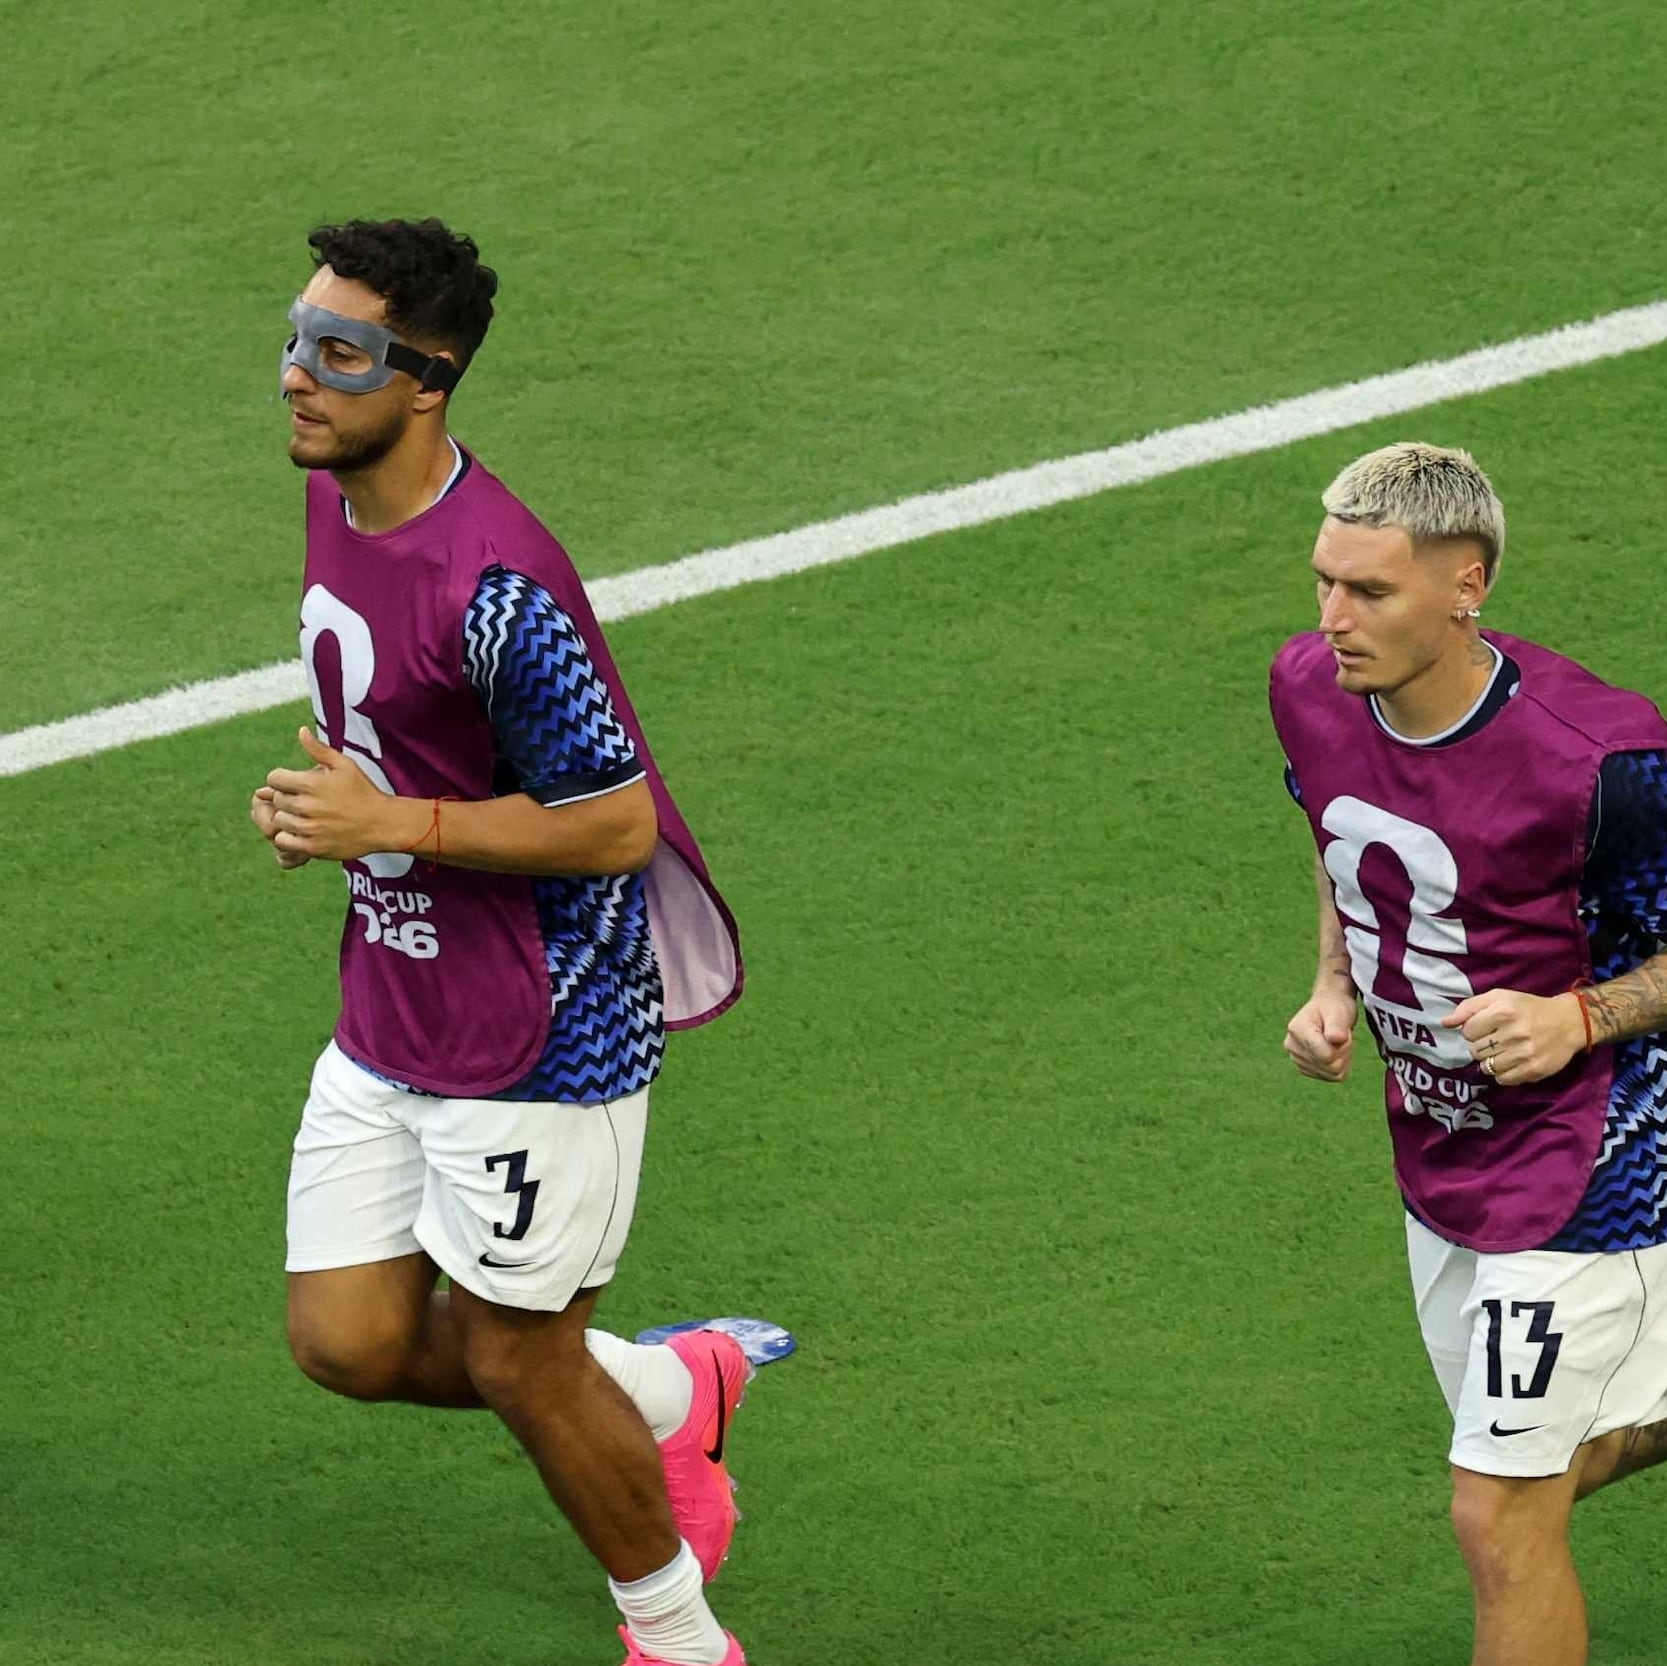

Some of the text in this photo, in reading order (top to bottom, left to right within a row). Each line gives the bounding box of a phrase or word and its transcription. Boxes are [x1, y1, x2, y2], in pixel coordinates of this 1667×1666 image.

[379, 890, 433, 914] CUP
[1373, 1005, 1438, 1048] FIFA
[485, 1150, 540, 1240] 3
[1482, 1300, 1563, 1398] 13
